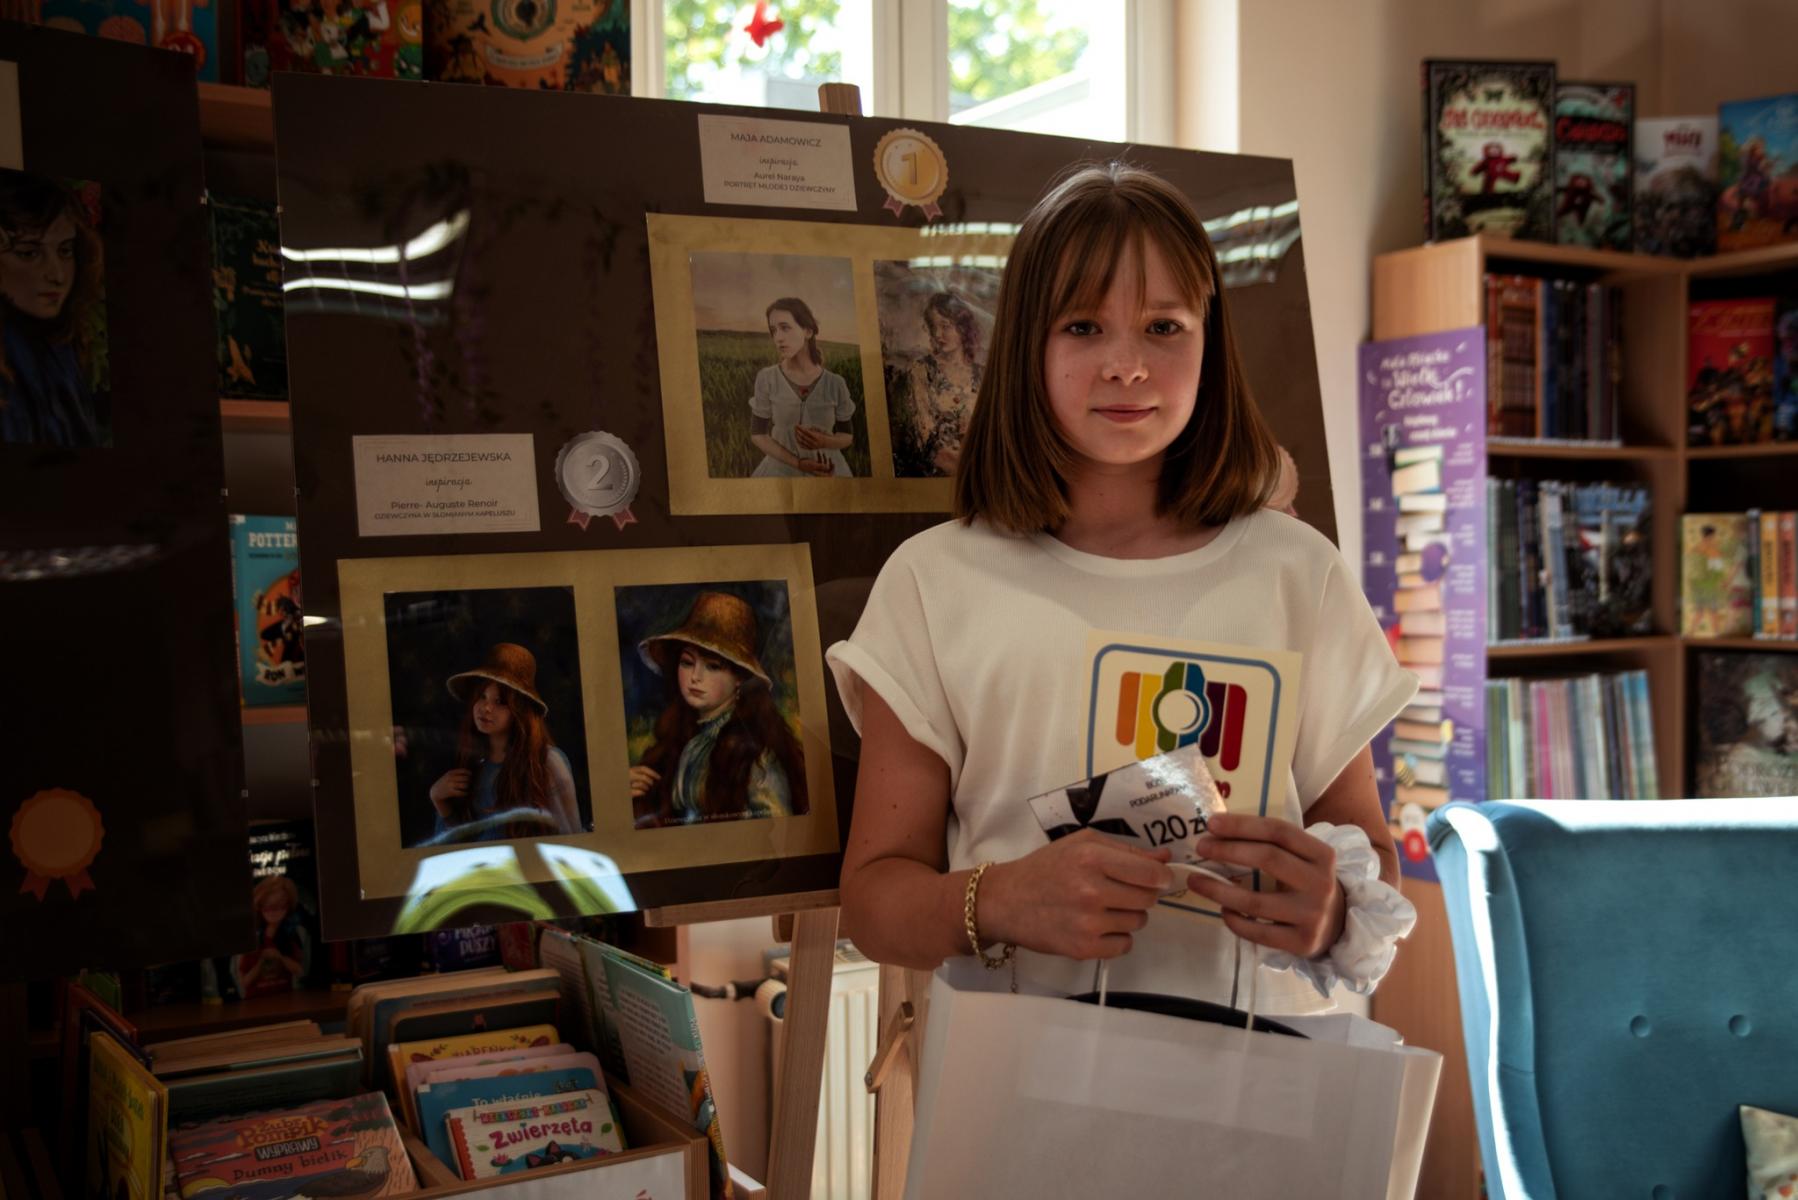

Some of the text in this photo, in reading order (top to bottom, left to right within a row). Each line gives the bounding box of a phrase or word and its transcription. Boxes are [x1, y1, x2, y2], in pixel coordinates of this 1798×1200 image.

[730, 132, 822, 148] MAJA ADAMOWICZ
[753, 171, 775, 181] Aurel
[901, 151, 918, 186] 1
[376, 452, 512, 464] HANNA JĘDRZEJEWSKA
[585, 453, 614, 492] 2
[425, 476, 473, 493] inspiracja
[390, 499, 498, 511] Pierre- Auguste Renoir
[1142, 814, 1188, 848] 120
[488, 1117, 593, 1150] Zwierzęta
[256, 1137, 320, 1159] WYPRAWY
[232, 1149, 348, 1181] Dumny bielik
